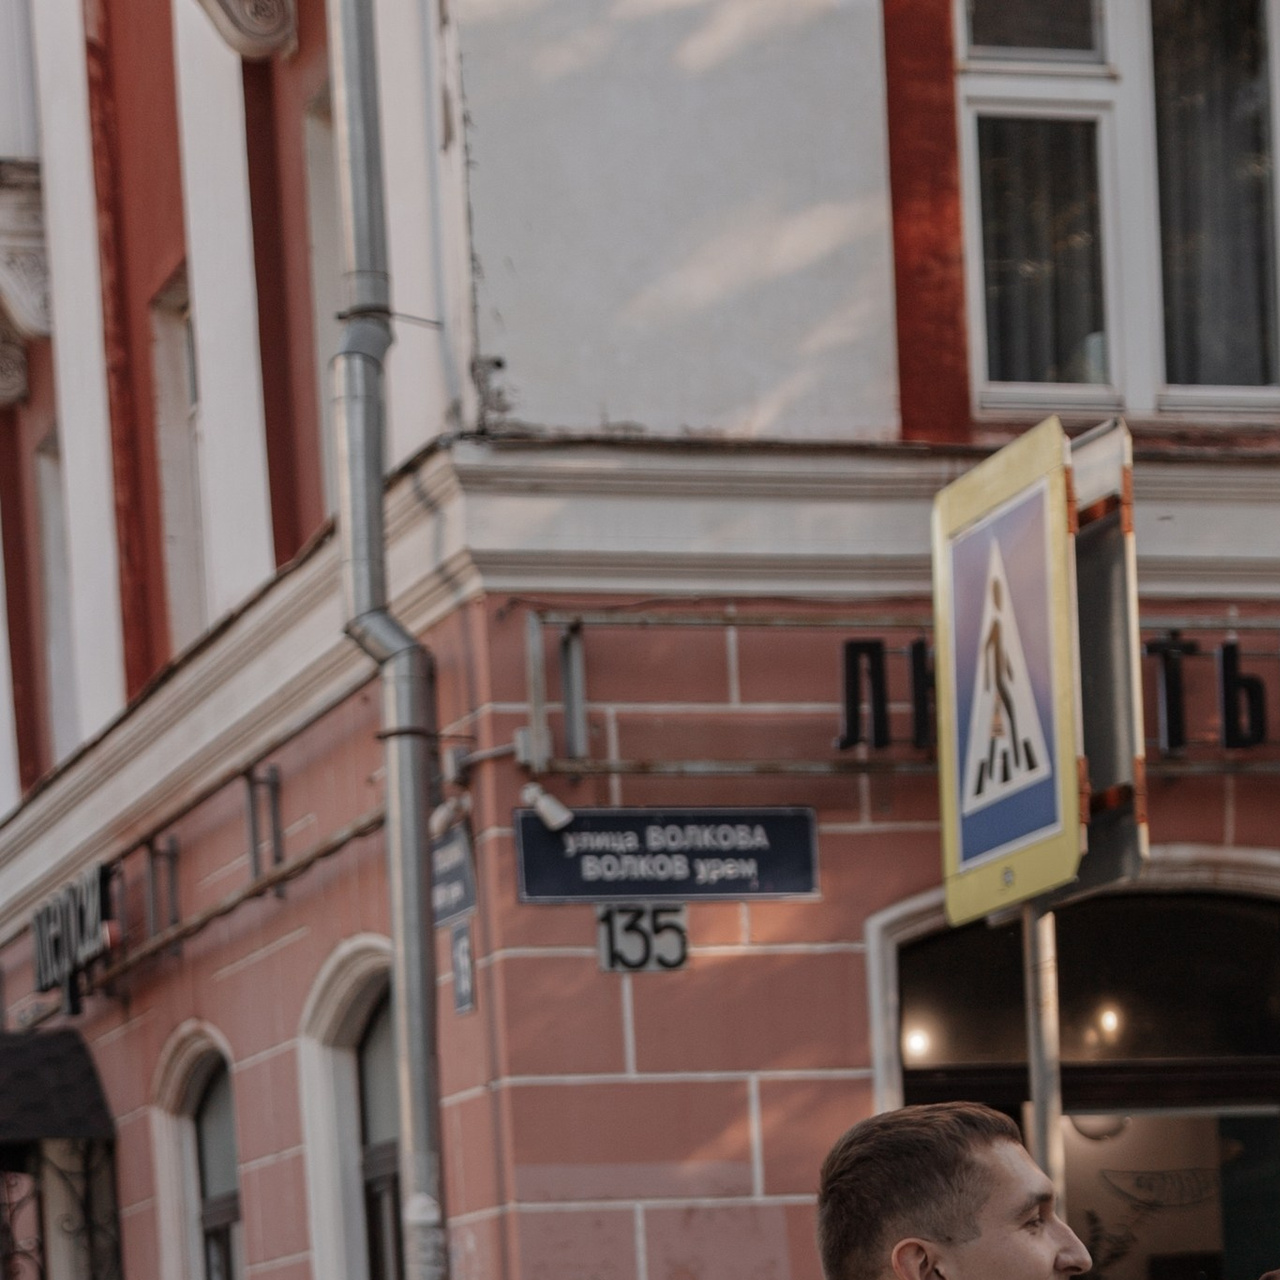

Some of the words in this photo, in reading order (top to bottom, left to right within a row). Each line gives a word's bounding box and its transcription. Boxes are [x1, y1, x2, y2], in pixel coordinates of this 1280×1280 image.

[563, 829, 639, 857] улица
[645, 824, 770, 851] ВОЛКОВА
[581, 854, 690, 881] ВОЛКОВ
[597, 906, 689, 969] 135
